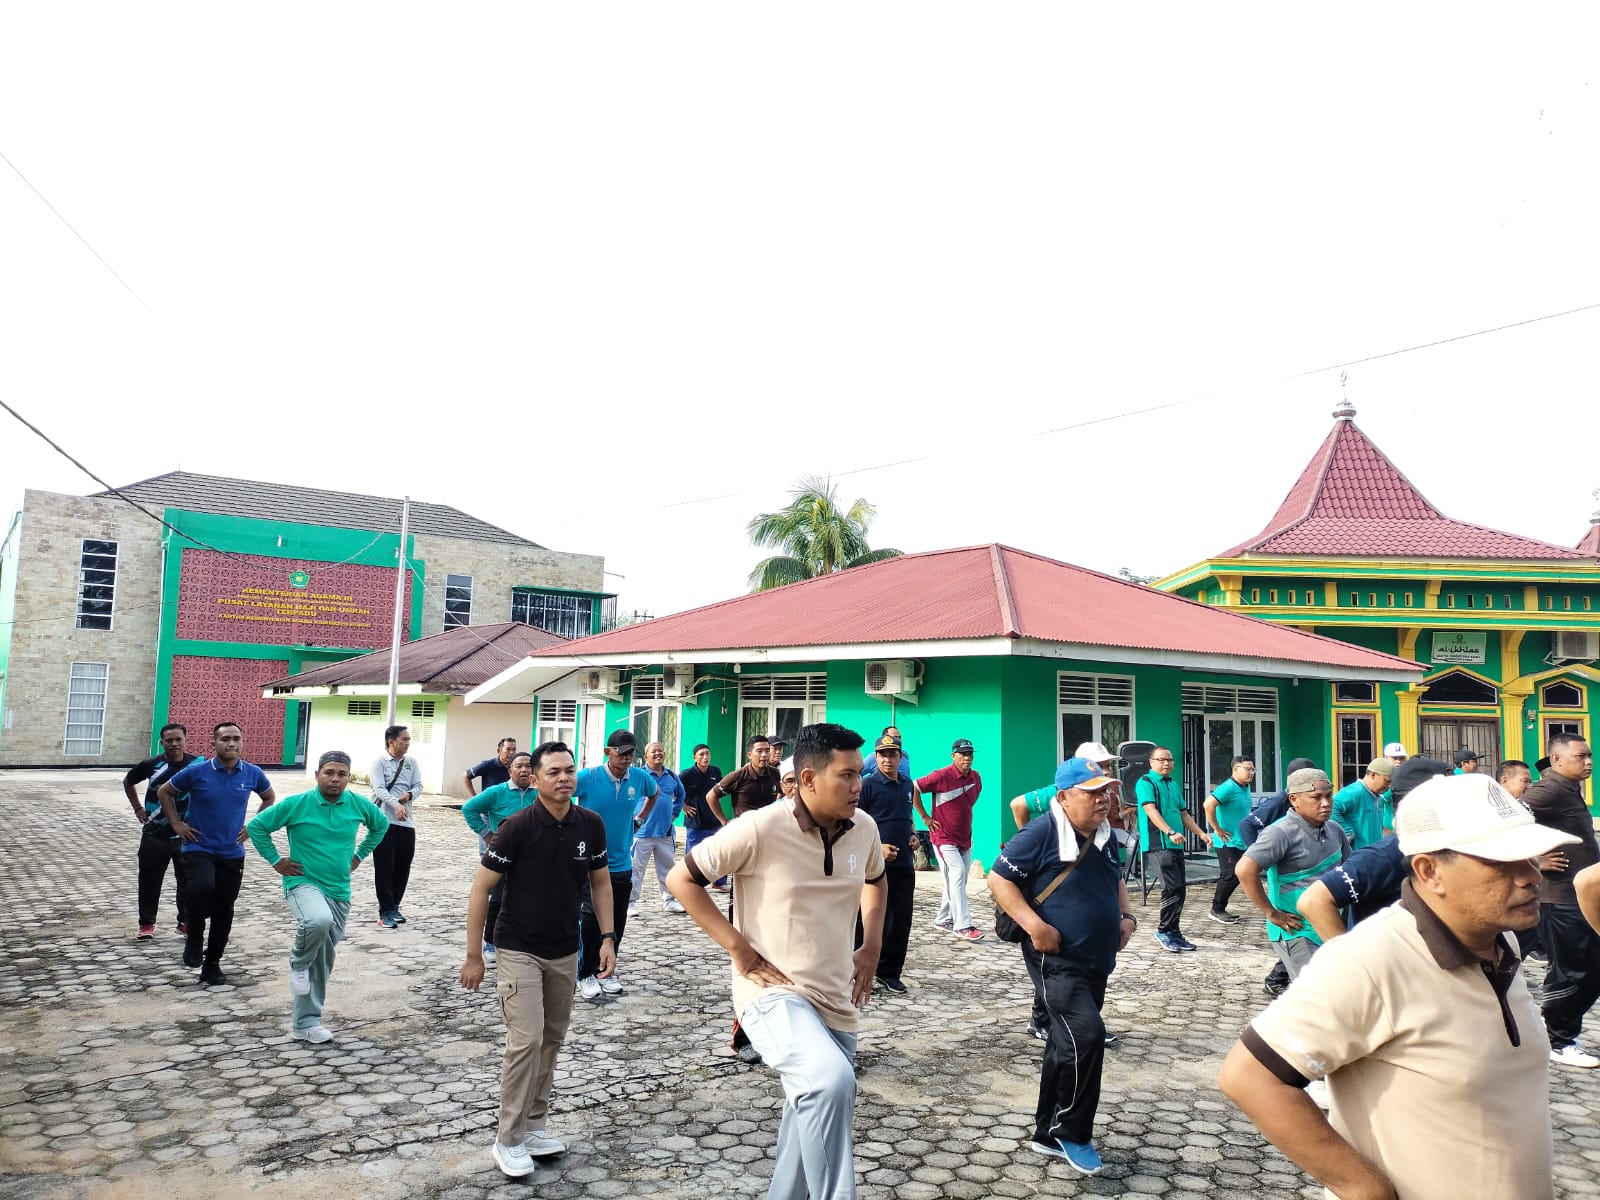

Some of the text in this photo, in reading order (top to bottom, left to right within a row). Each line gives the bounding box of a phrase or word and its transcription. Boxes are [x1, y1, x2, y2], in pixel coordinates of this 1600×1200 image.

[242, 587, 307, 597] KEMENTERIAN
[310, 593, 341, 601] AGAMA
[217, 597, 249, 607] PUSAT
[251, 600, 293, 610] LAYANAN
[338, 607, 370, 615] UMRAH
[276, 609, 317, 617] TERPADU
